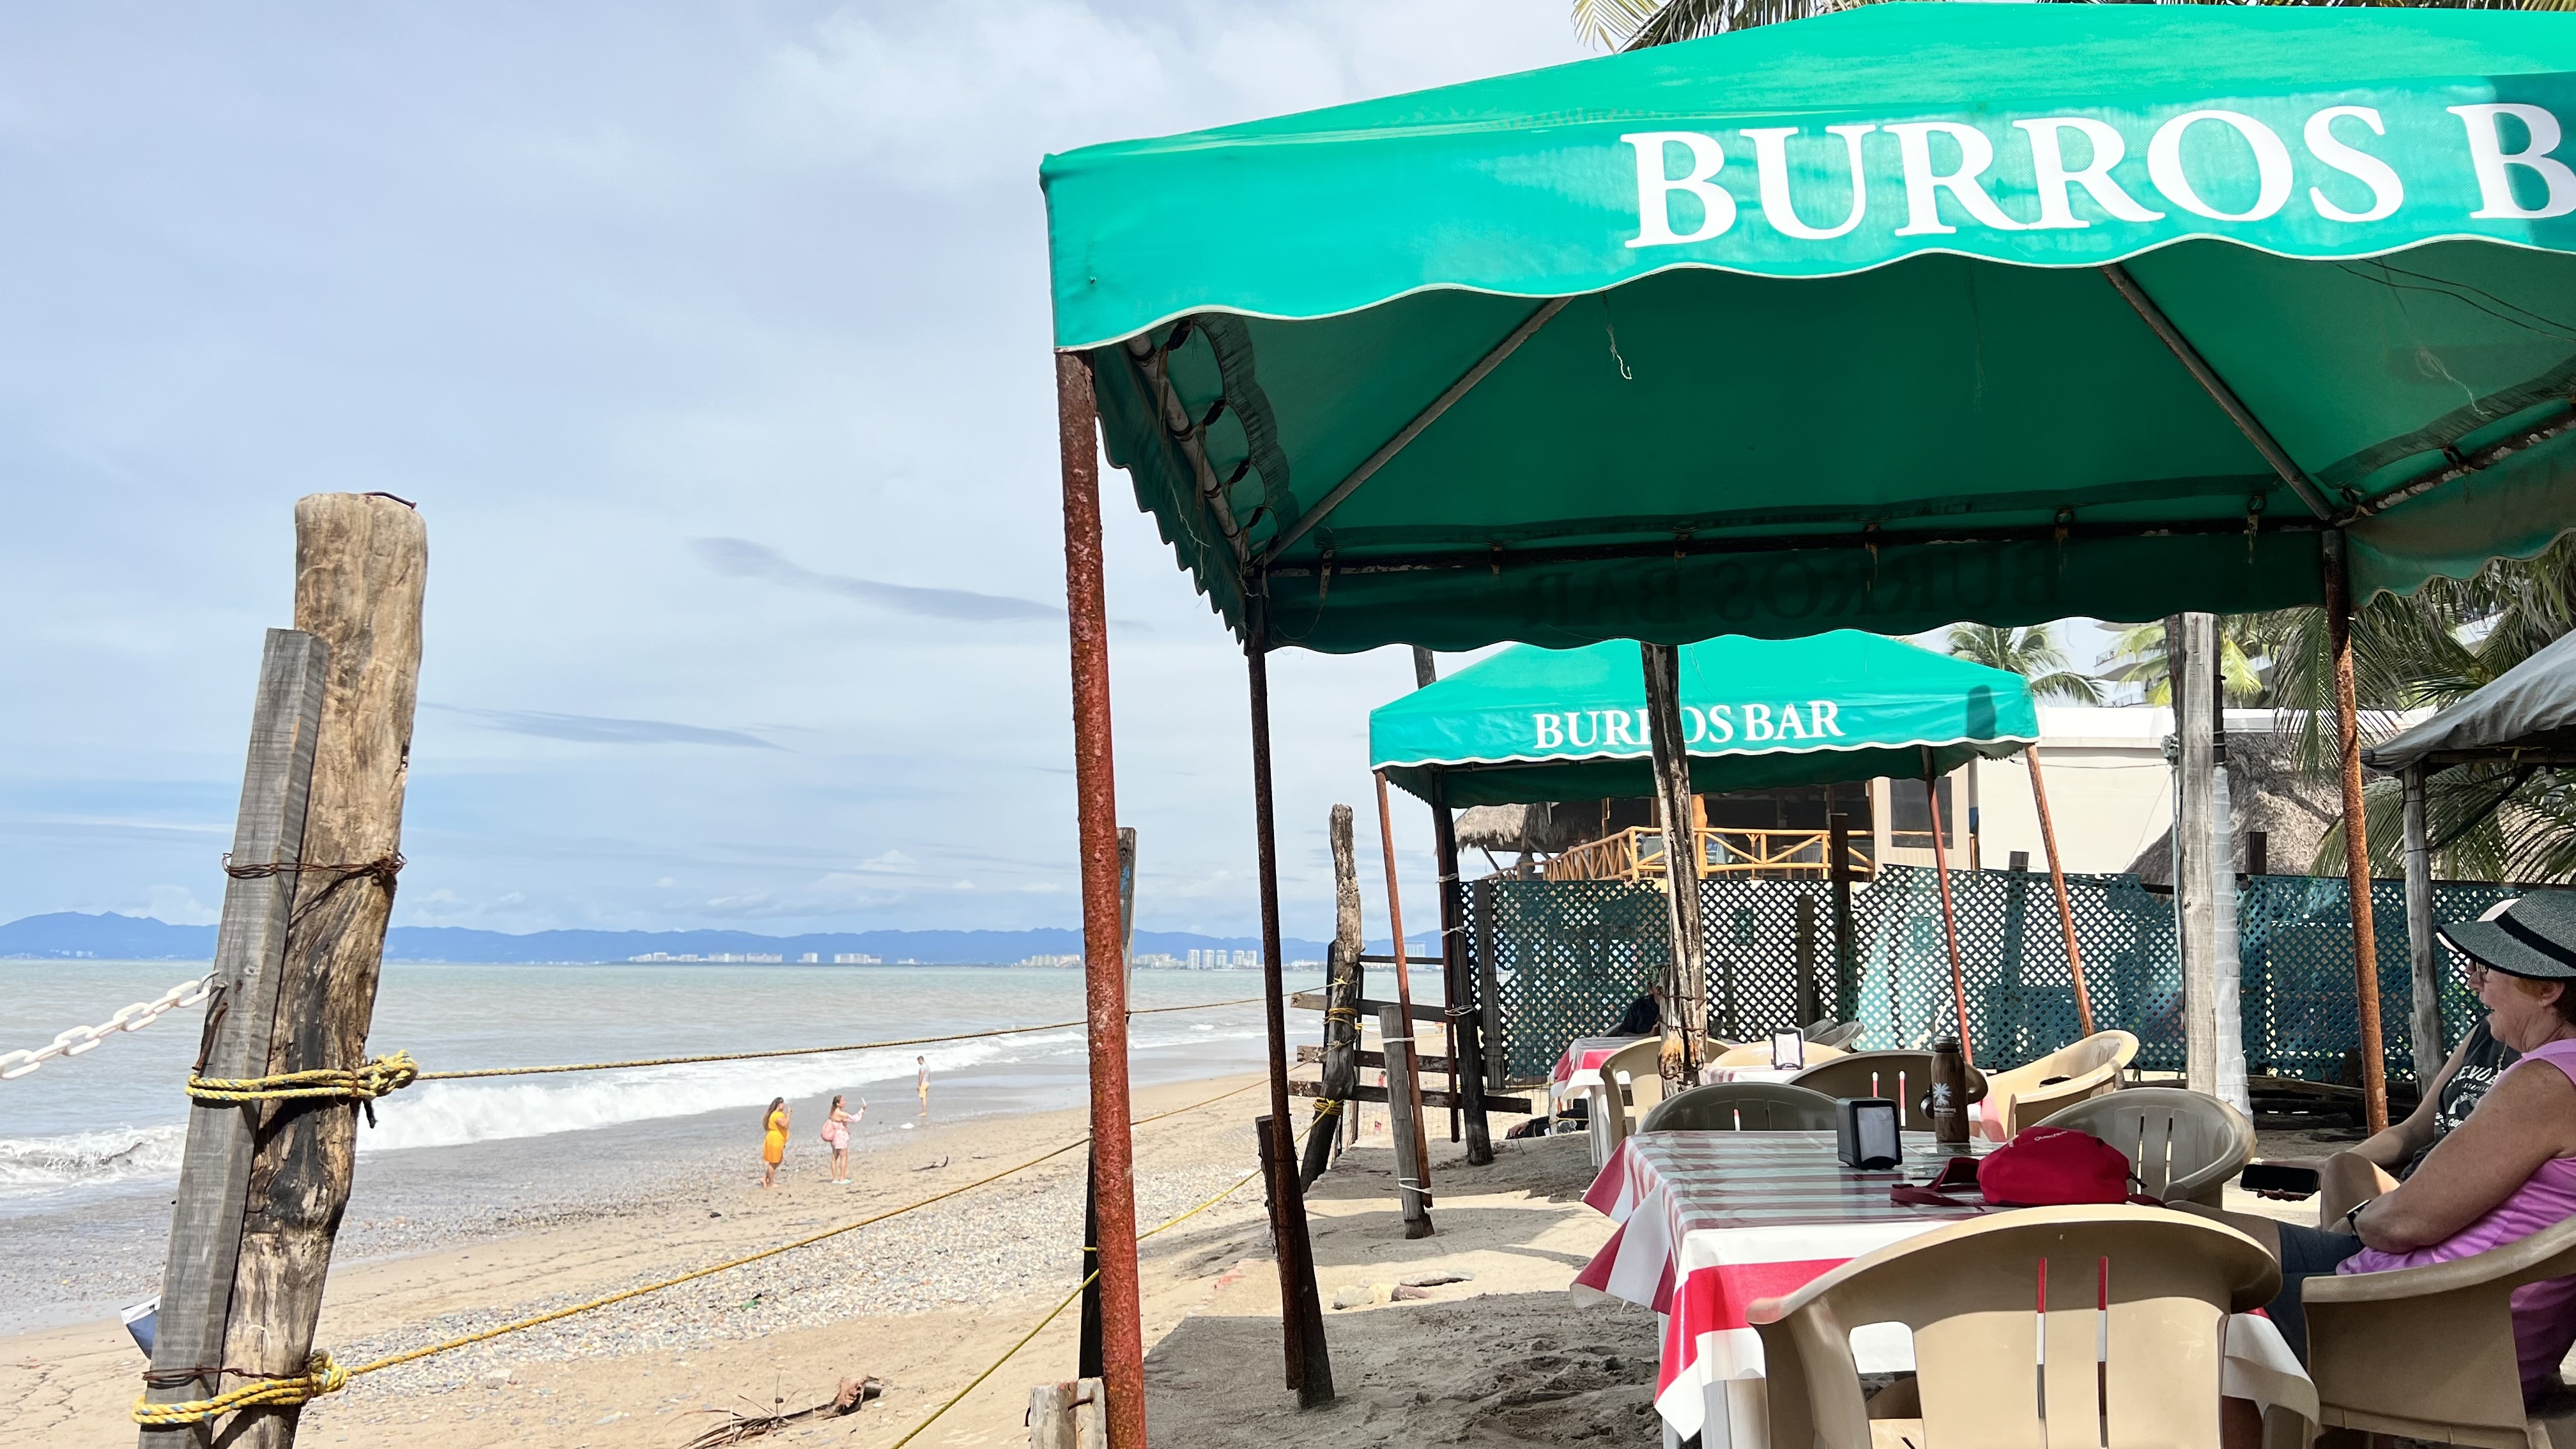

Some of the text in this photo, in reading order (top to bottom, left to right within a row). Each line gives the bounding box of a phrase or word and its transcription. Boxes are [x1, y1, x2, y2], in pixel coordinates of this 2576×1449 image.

[1621, 103, 2576, 249] BURROS B
[1742, 700, 1846, 742] BAR
